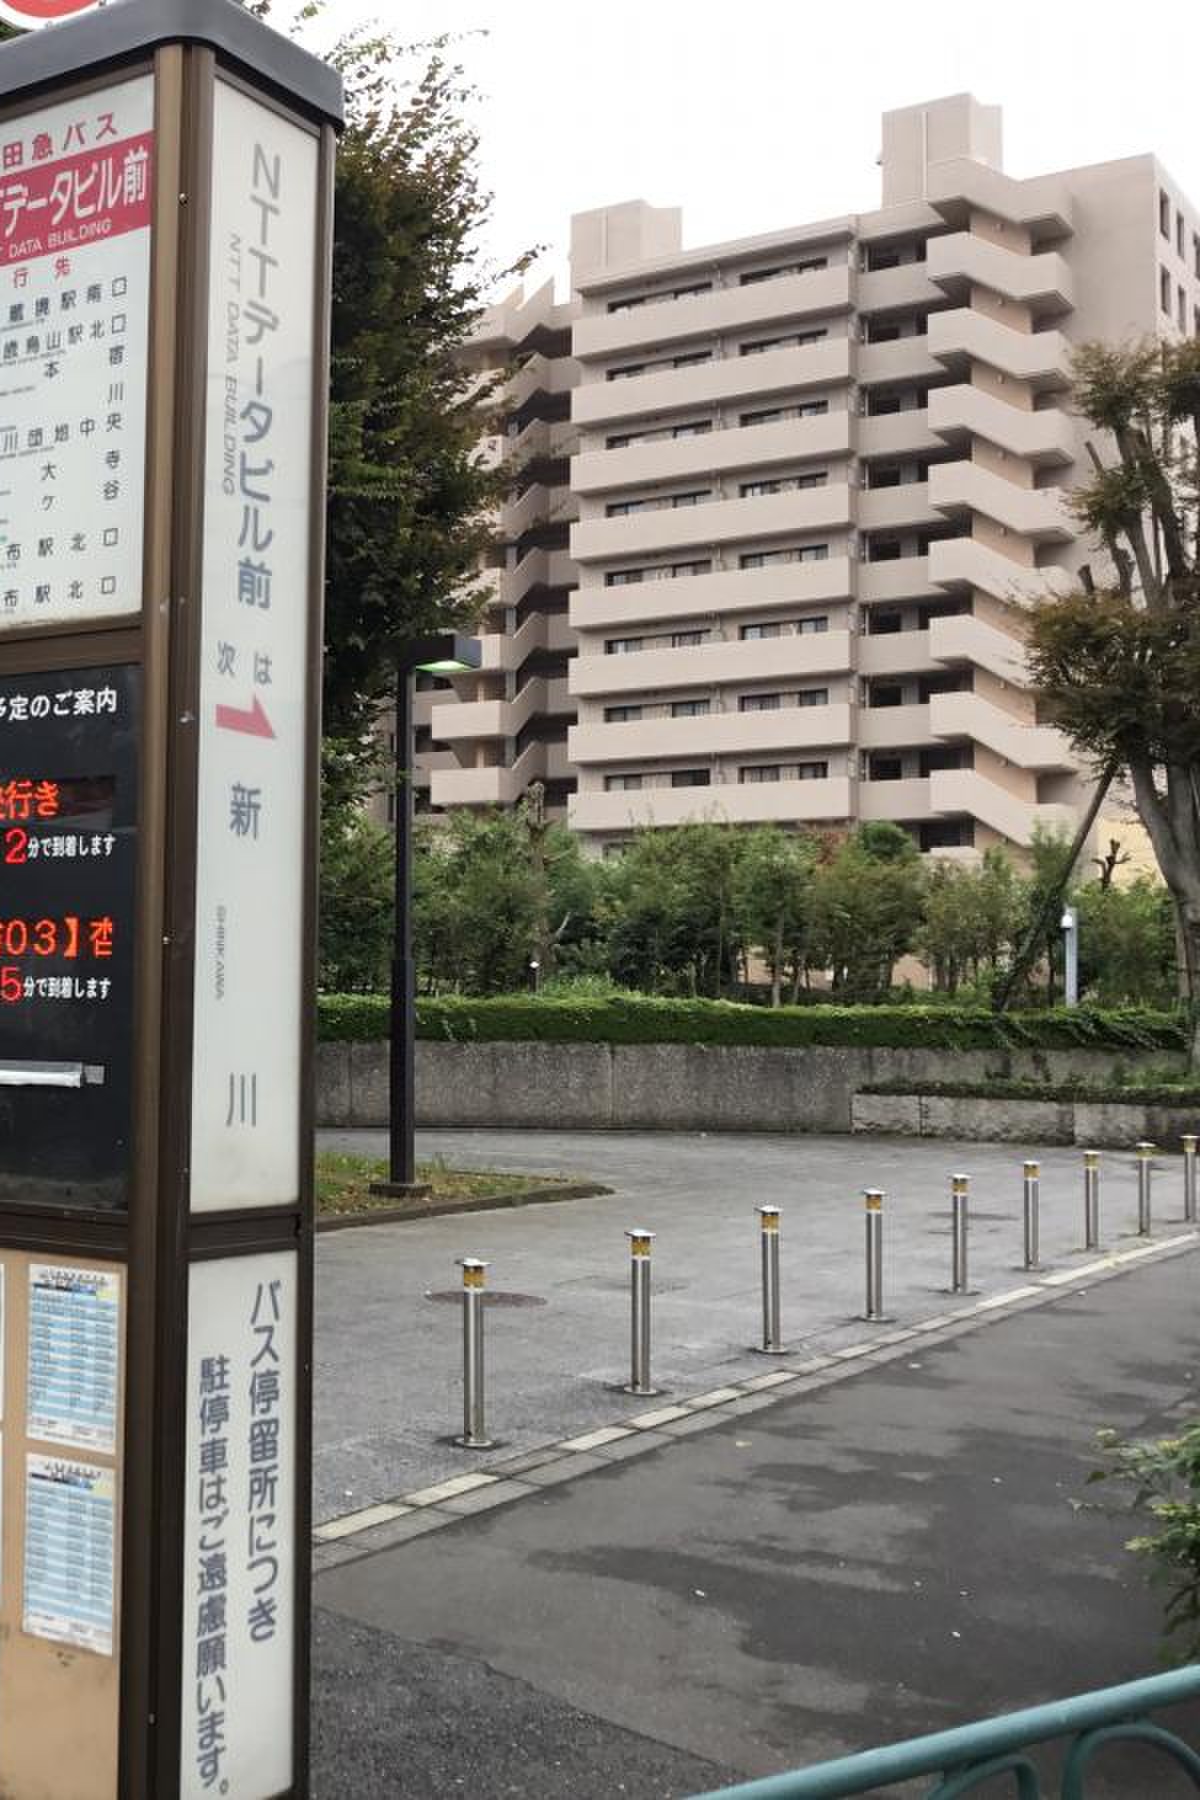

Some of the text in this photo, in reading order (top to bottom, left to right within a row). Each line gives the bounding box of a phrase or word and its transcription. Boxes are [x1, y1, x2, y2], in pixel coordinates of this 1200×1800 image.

[9, 239, 42, 258] DATA
[48, 218, 111, 248] BUILDING
[222, 375, 238, 496] BUILDING
[238, 143, 280, 610] NTTデータビル前
[217, 640, 272, 686] 次は
[196, 1355, 230, 1795] 駐停車はご遠慮願います。
[248, 1280, 280, 1643] バス停留所につき
